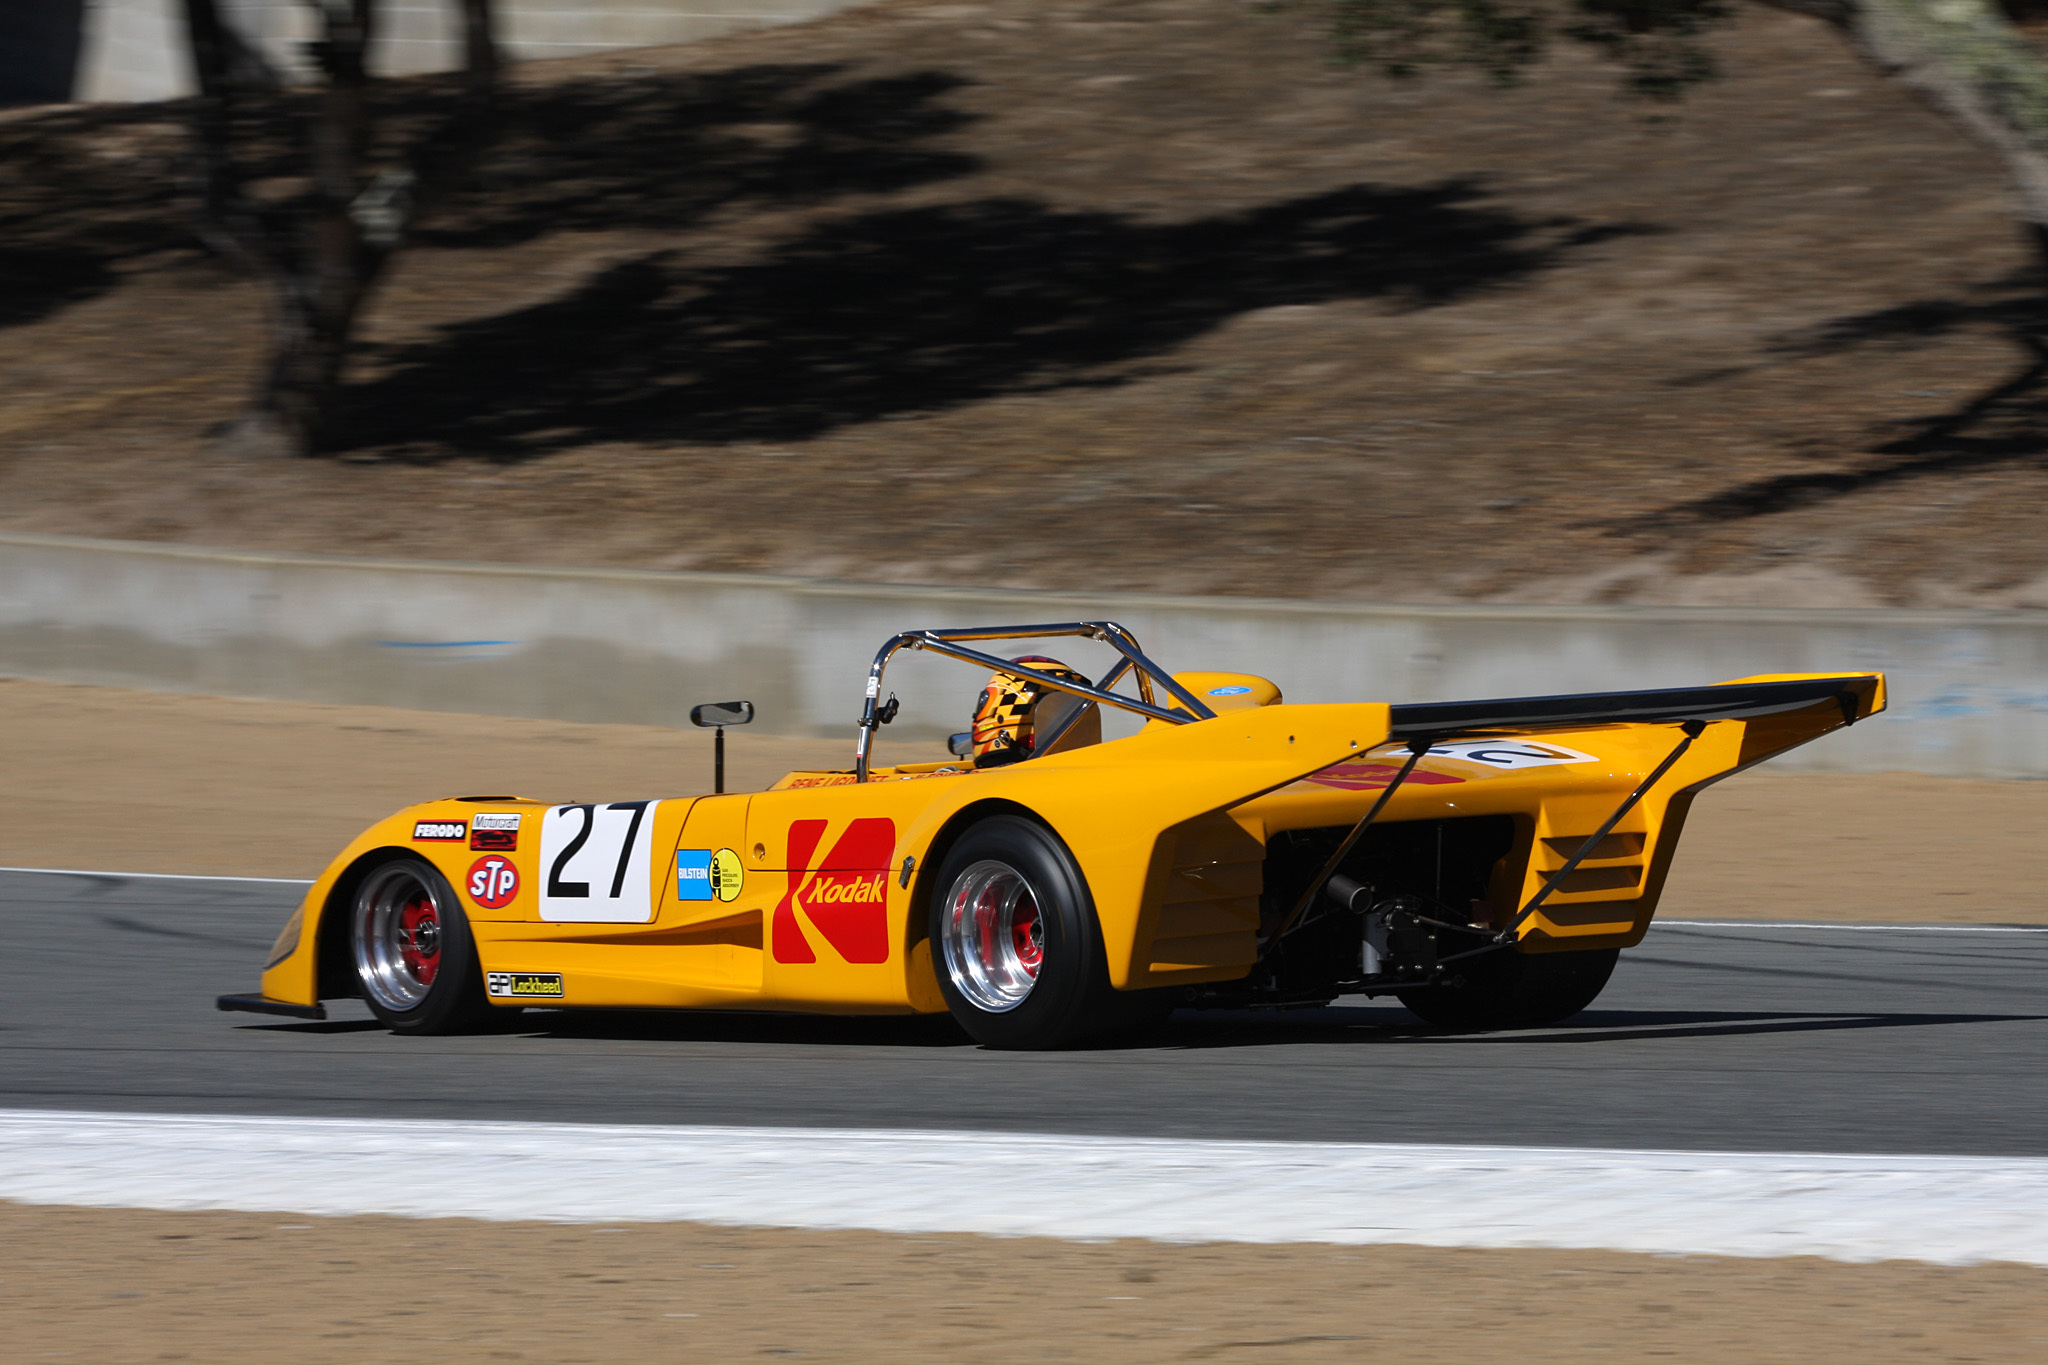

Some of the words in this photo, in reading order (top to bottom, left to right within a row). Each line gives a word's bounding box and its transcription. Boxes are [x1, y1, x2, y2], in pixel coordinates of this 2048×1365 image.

[414, 824, 465, 838] FERODO
[475, 816, 520, 829] Motorcraft
[547, 800, 653, 898] 27
[470, 860, 516, 902] STP
[678, 867, 708, 879] BILSTEIN
[806, 873, 884, 903] Kodak
[511, 976, 562, 994] Lockheed
